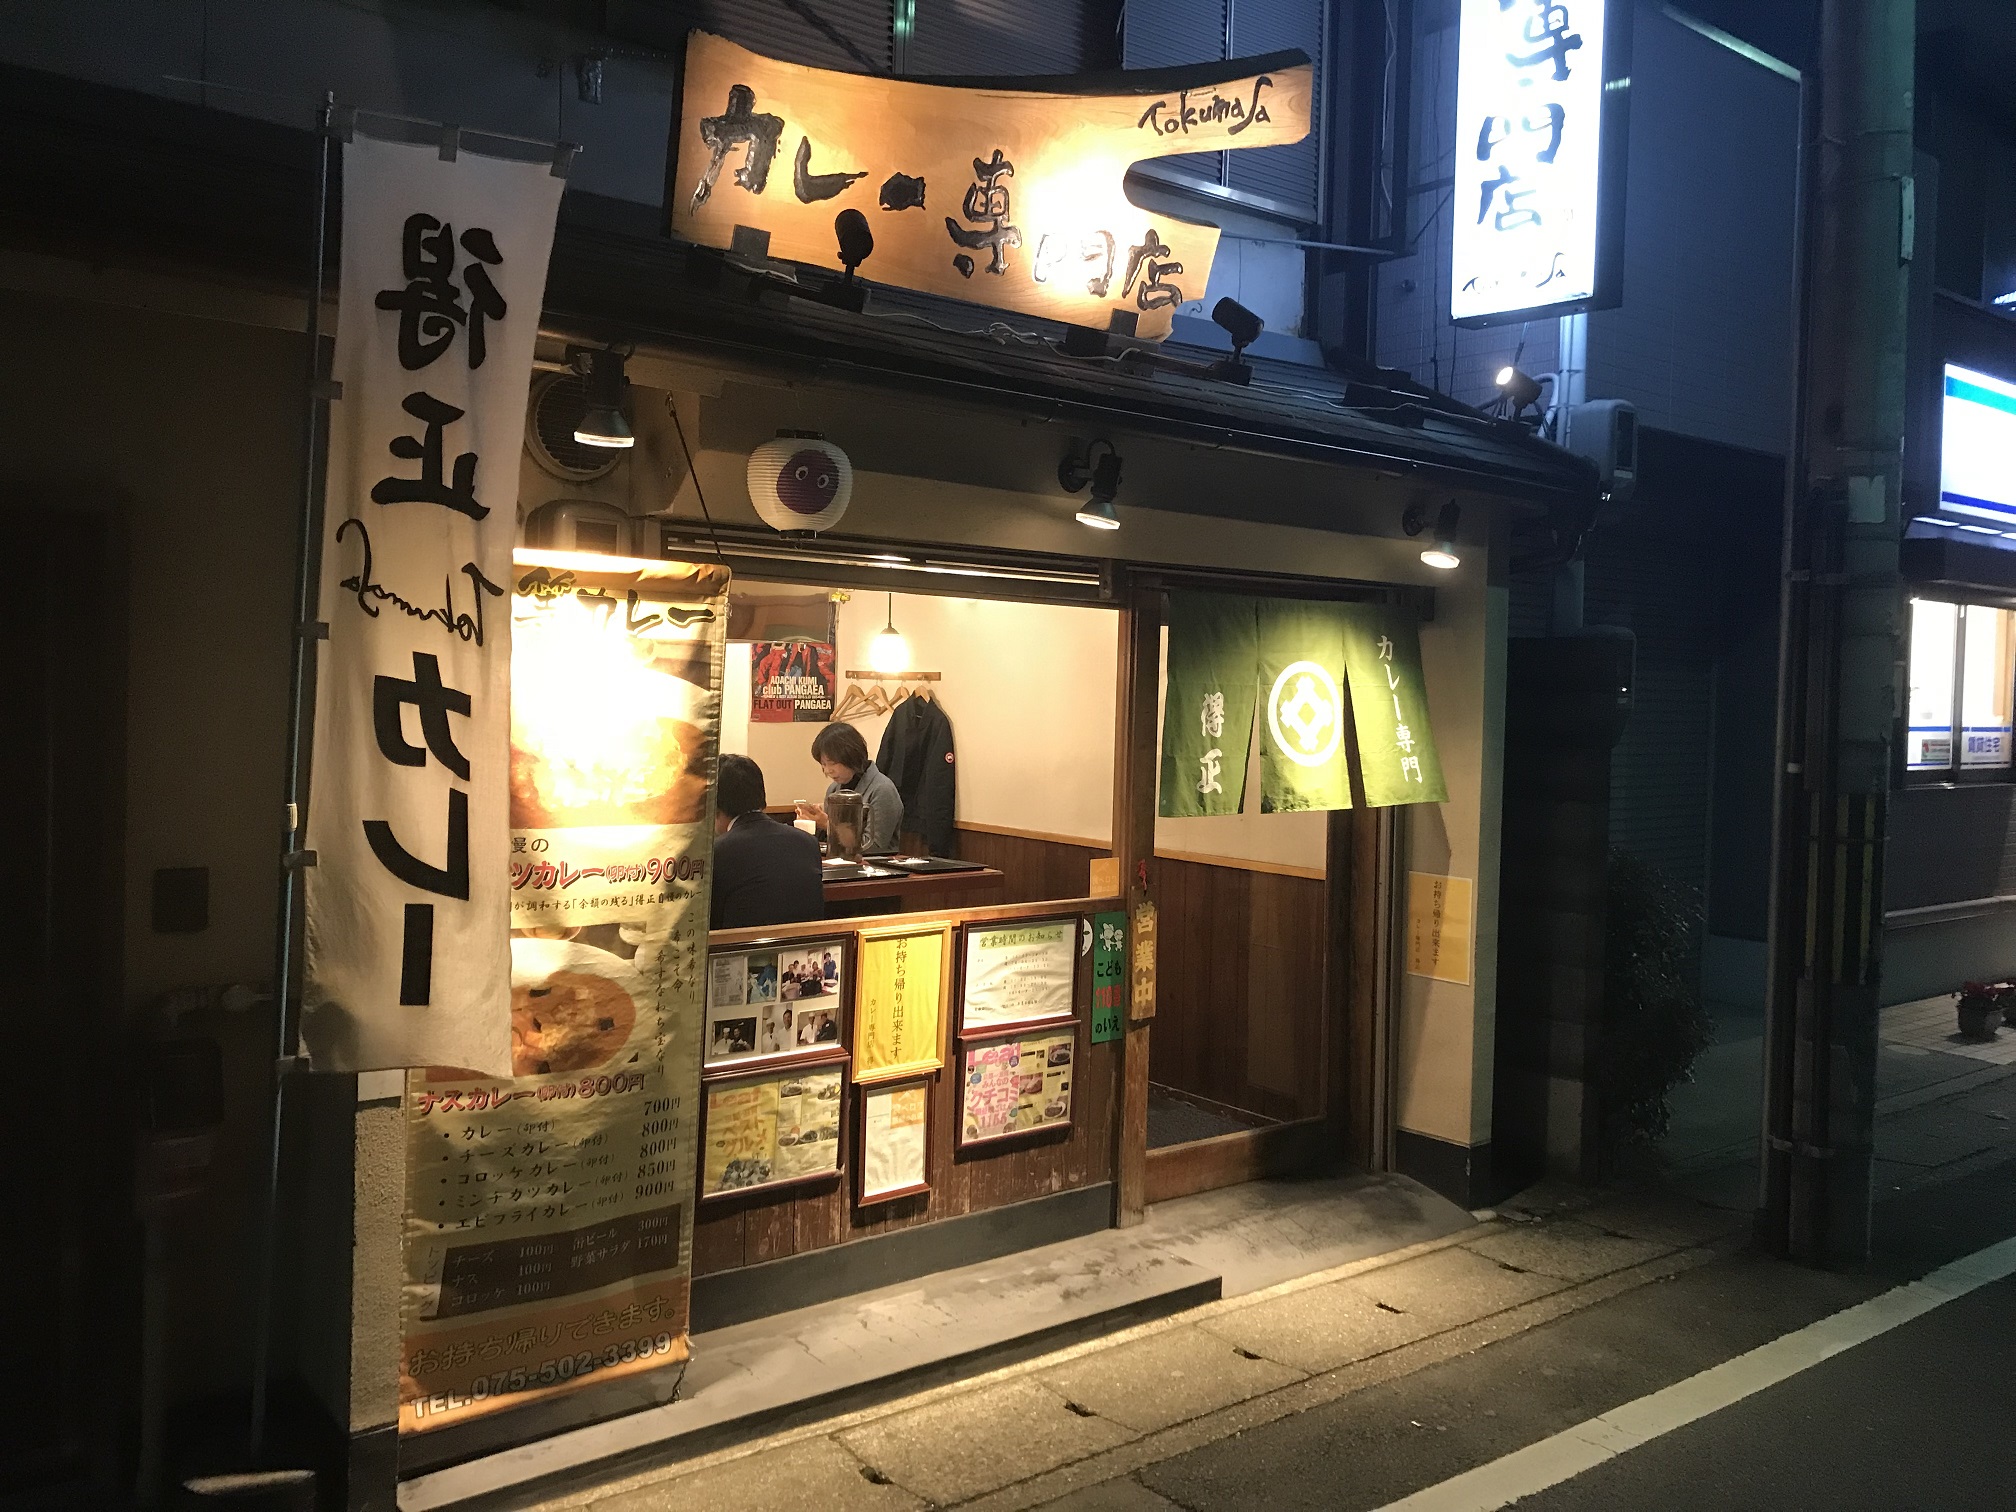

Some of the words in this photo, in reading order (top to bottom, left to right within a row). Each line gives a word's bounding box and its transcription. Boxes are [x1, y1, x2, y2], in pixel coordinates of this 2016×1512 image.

[762, 684, 782, 695] club
[784, 685, 824, 695] PANGAEA
[770, 676, 796, 685] ADACHI
[798, 676, 817, 685] KUMI
[754, 699, 774, 709] FLAT
[776, 699, 792, 709] OUT
[794, 699, 832, 710] PANGAEA
[1377, 635, 1422, 783] カレー専門
[979, 930, 1063, 948] 営業時間のお知らせ
[1134, 900, 1156, 1007] 営業中
[1097, 960, 1122, 977] こども
[891, 938, 908, 1059] お持ち帰り出来ます
[1095, 1015, 1120, 1034] のいえ
